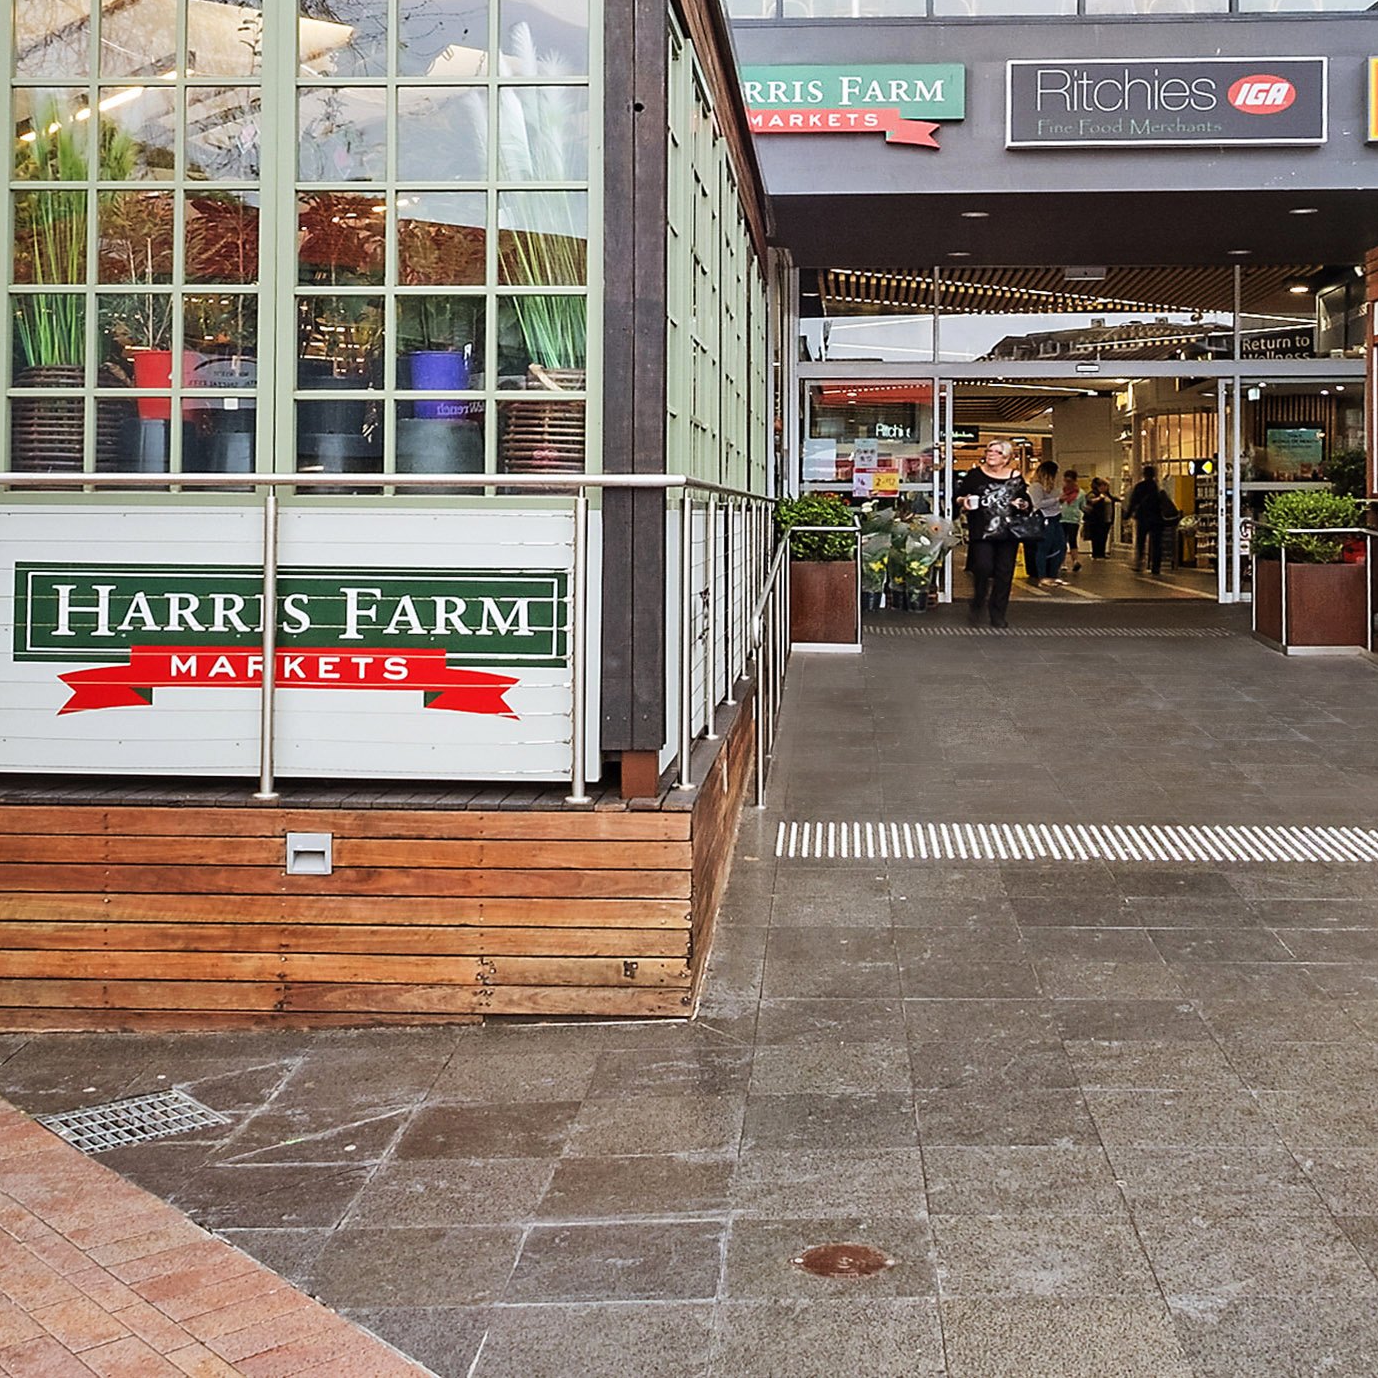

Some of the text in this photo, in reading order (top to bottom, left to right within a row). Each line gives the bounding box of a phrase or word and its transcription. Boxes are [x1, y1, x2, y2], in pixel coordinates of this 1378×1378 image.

[744, 77, 946, 105] RRIS FARM
[1037, 69, 1290, 111] Ritchies IGA
[751, 113, 879, 127] MARKETS
[1037, 118, 1222, 135] Fine Food Merchants
[1242, 335, 1310, 351] Return to
[339, 586, 534, 640] FARM
[171, 655, 410, 680] MARKETS
